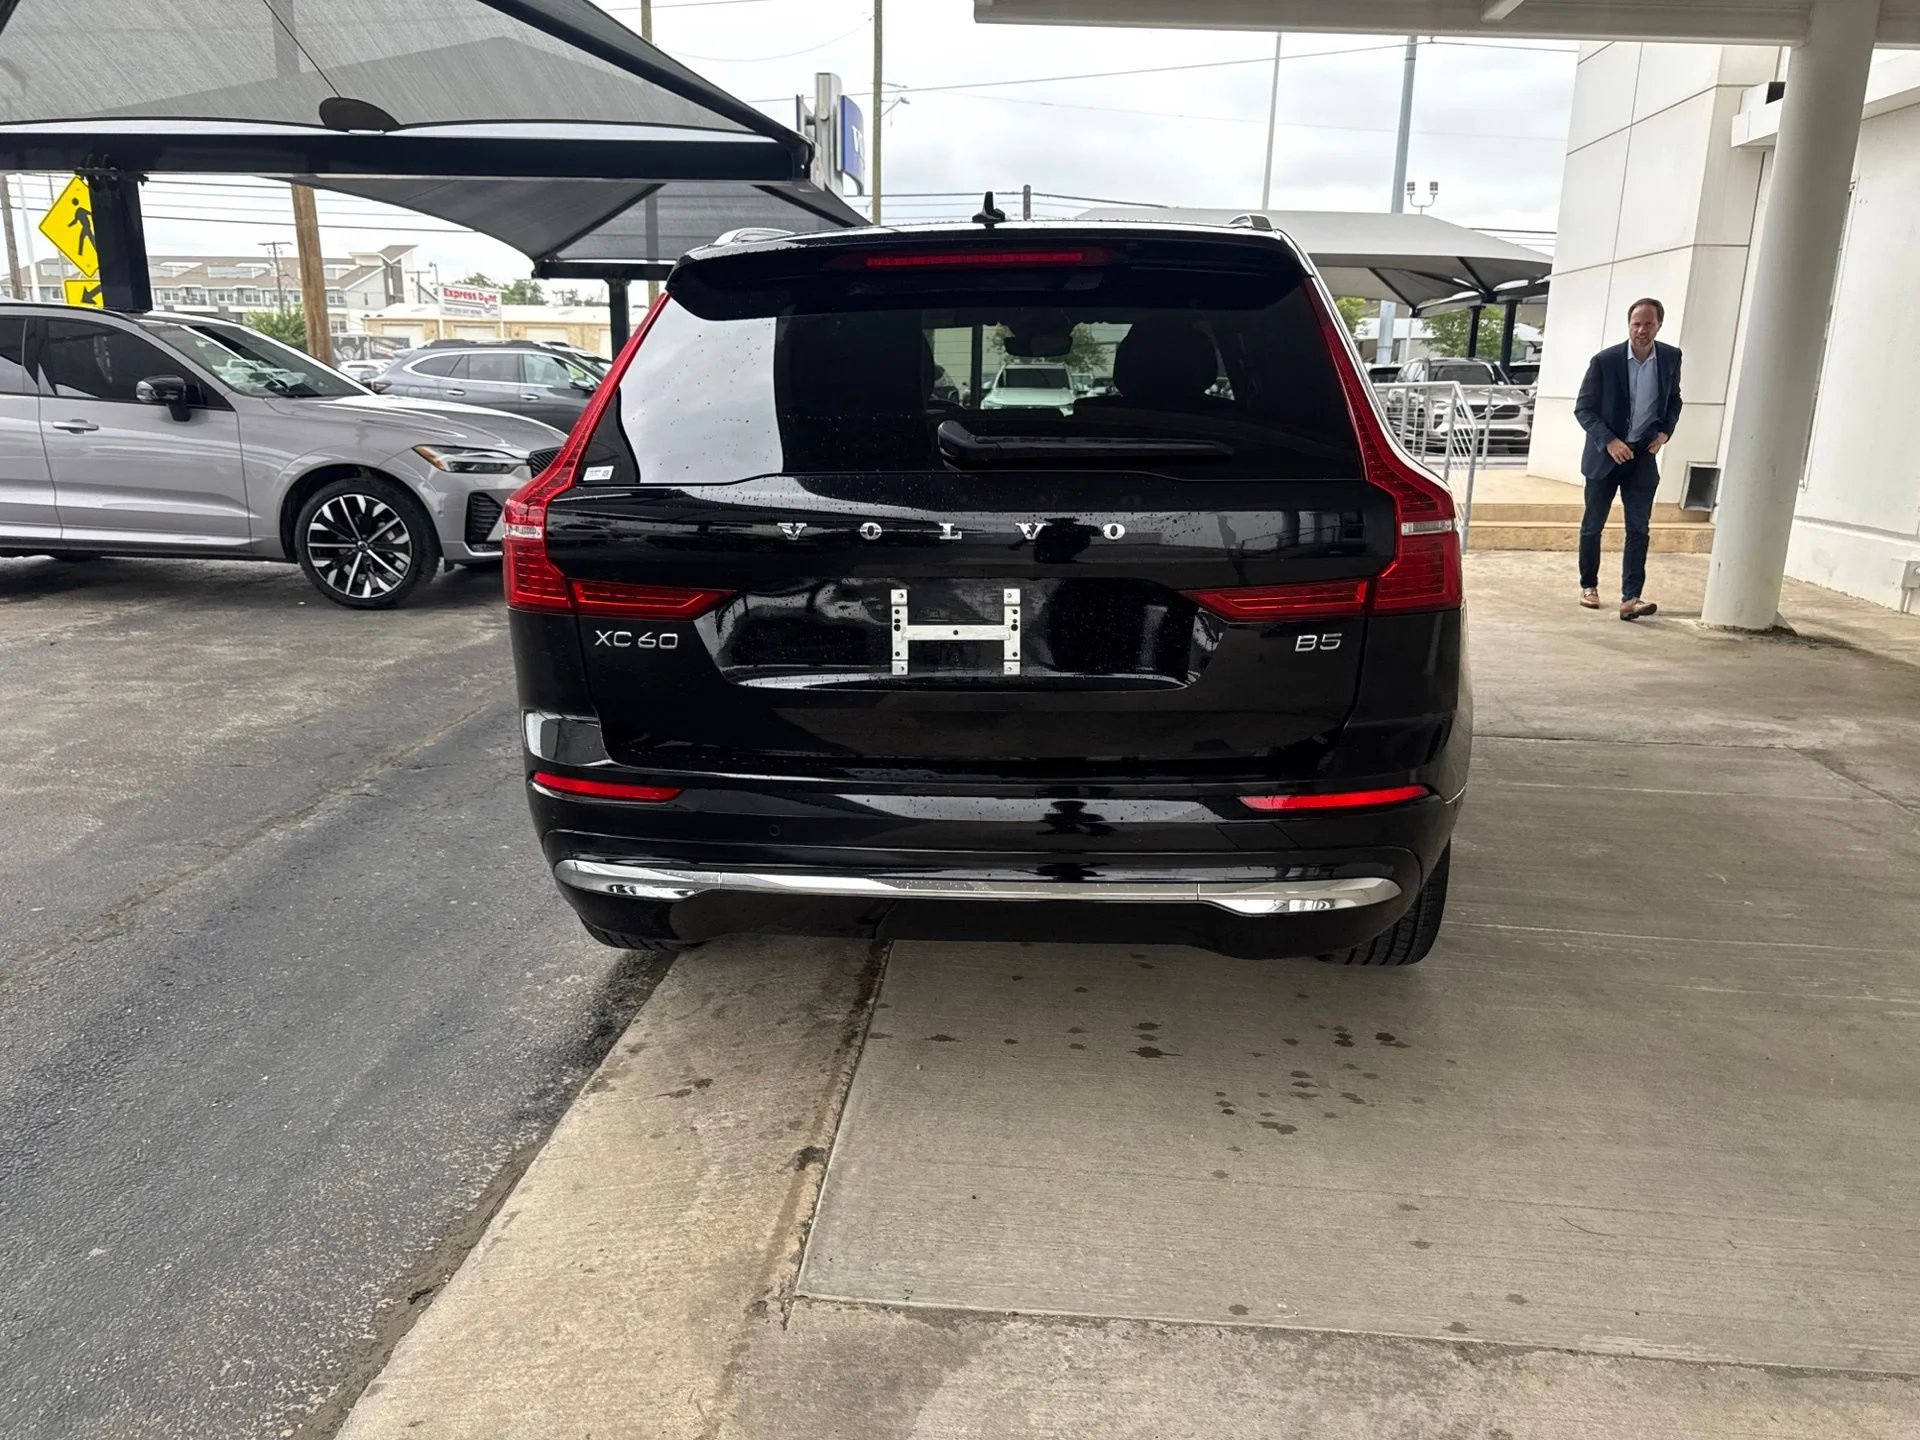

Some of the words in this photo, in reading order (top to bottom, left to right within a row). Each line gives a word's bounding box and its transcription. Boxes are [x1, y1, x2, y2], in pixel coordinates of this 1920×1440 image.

[443, 287, 477, 300] Express
[776, 522, 1126, 541] VOLVO
[1294, 633, 1343, 652] B5
